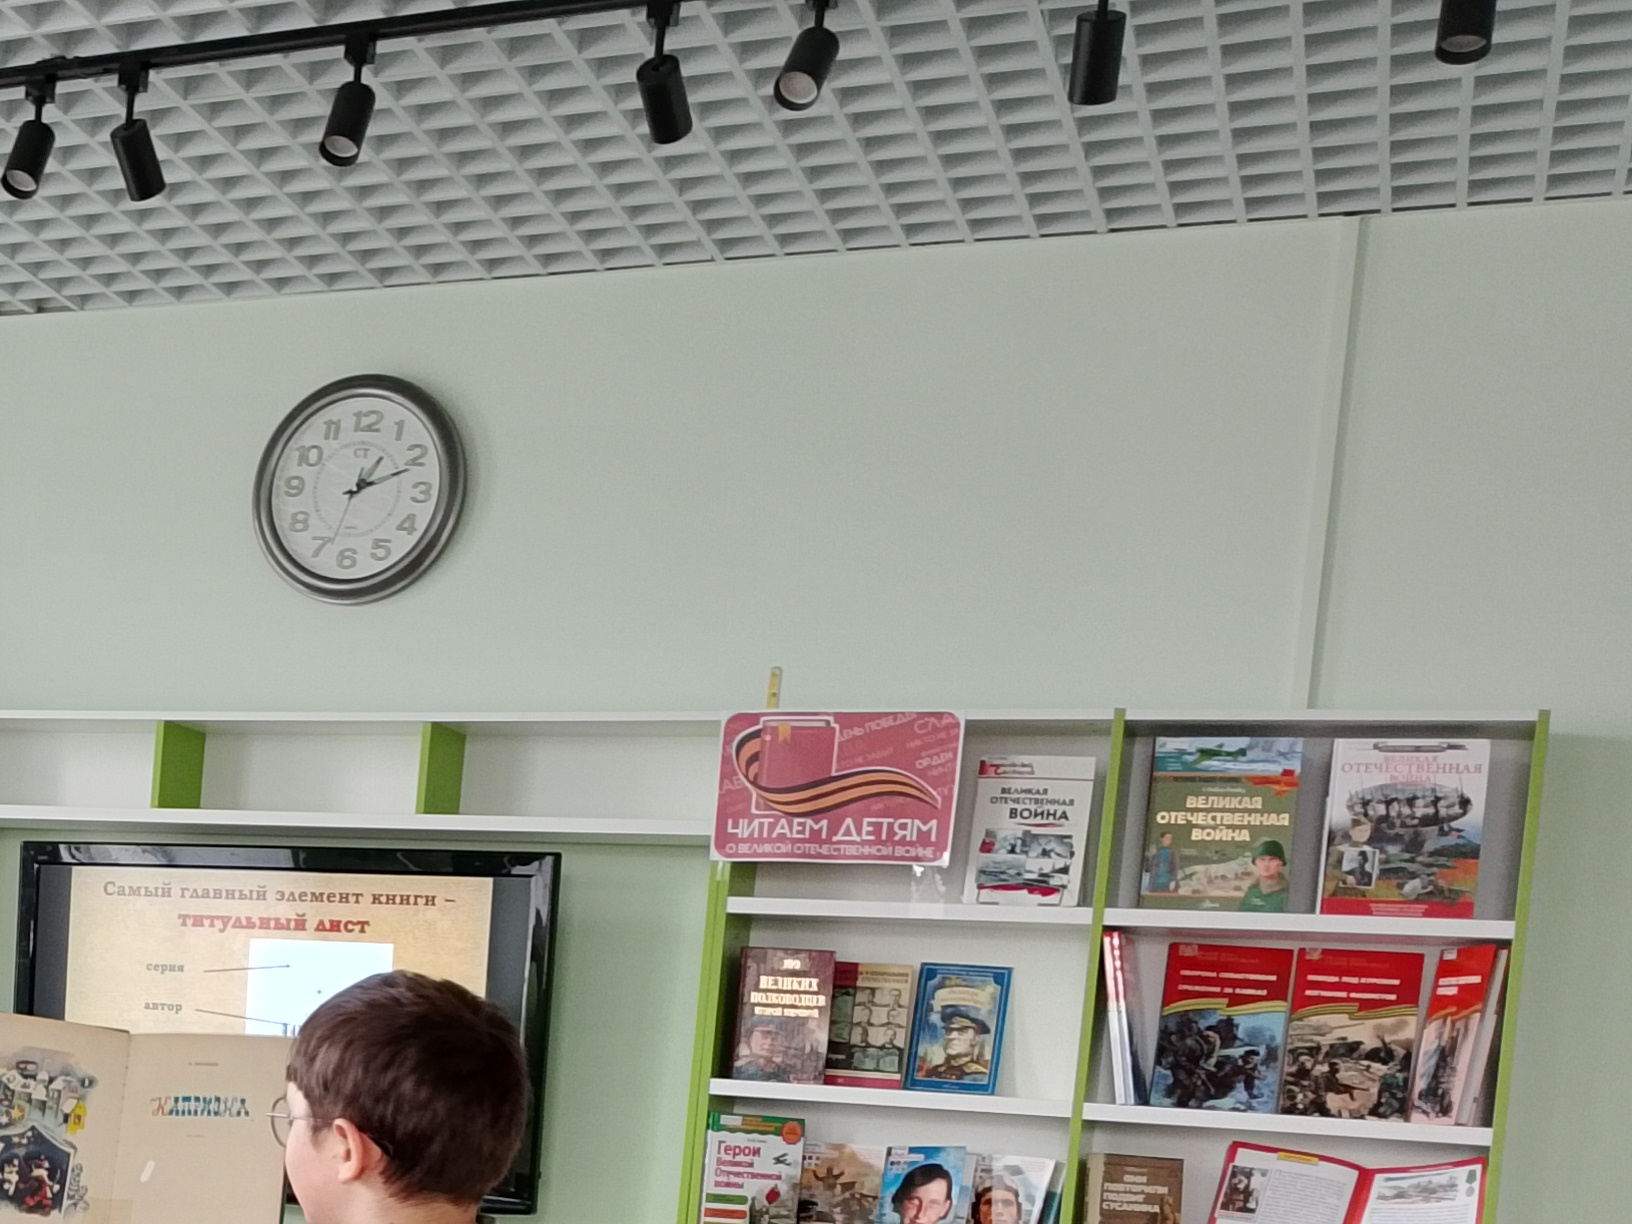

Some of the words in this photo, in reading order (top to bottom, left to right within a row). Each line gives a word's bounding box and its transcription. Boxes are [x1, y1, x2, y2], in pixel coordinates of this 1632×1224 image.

[323, 419, 341, 441] 11
[353, 410, 384, 433] 12
[394, 419, 405, 441] 1
[296, 445, 324, 467] 10
[404, 444, 428, 466] 2
[284, 476, 305, 497] 9
[410, 481, 432, 503] 3
[289, 511, 310, 533] 8
[396, 513, 417, 535] 4
[311, 536, 331, 558] 7
[370, 538, 392, 561] 5
[336, 548, 358, 569] 6
[1341, 763, 1483, 774] ОТЕЧЕСТВЕННАЯ
[990, 796, 1075, 807] ОТЕЧЕСТВЕННАЯ
[1001, 786, 1048, 796] ВЕЛИКАЯ
[1186, 795, 1263, 809] ВЕЛИКАЯ
[1009, 806, 1070, 821] ВОЙНА
[1156, 811, 1290, 826] ОТЕЧЕСТВЕННАЯ
[726, 818, 828, 839] ЧИТАЕМ
[832, 817, 937, 842] ДЕТЯМ
[1191, 826, 1251, 841] ВОЙНА
[725, 843, 736, 854] О
[738, 841, 792, 854] ВЕЛИКОЙ
[793, 842, 892, 856] ОТЕЧЕСТВЕННОЙ
[894, 843, 935, 858] ВОЙНЕ
[103, 881, 173, 898] Самый
[180, 885, 268, 901] главный
[275, 890, 364, 904] элемент
[371, 893, 437, 906] книги
[178, 912, 307, 933] титульный
[314, 919, 370, 933] лист
[146, 963, 184, 975] серия
[759, 975, 819, 991] ВЕЛИКИХ
[144, 1002, 183, 1014] автор
[750, 991, 826, 1006] ПОЛКОВОДЦЕВ
[717, 1140, 761, 1159] Герои
